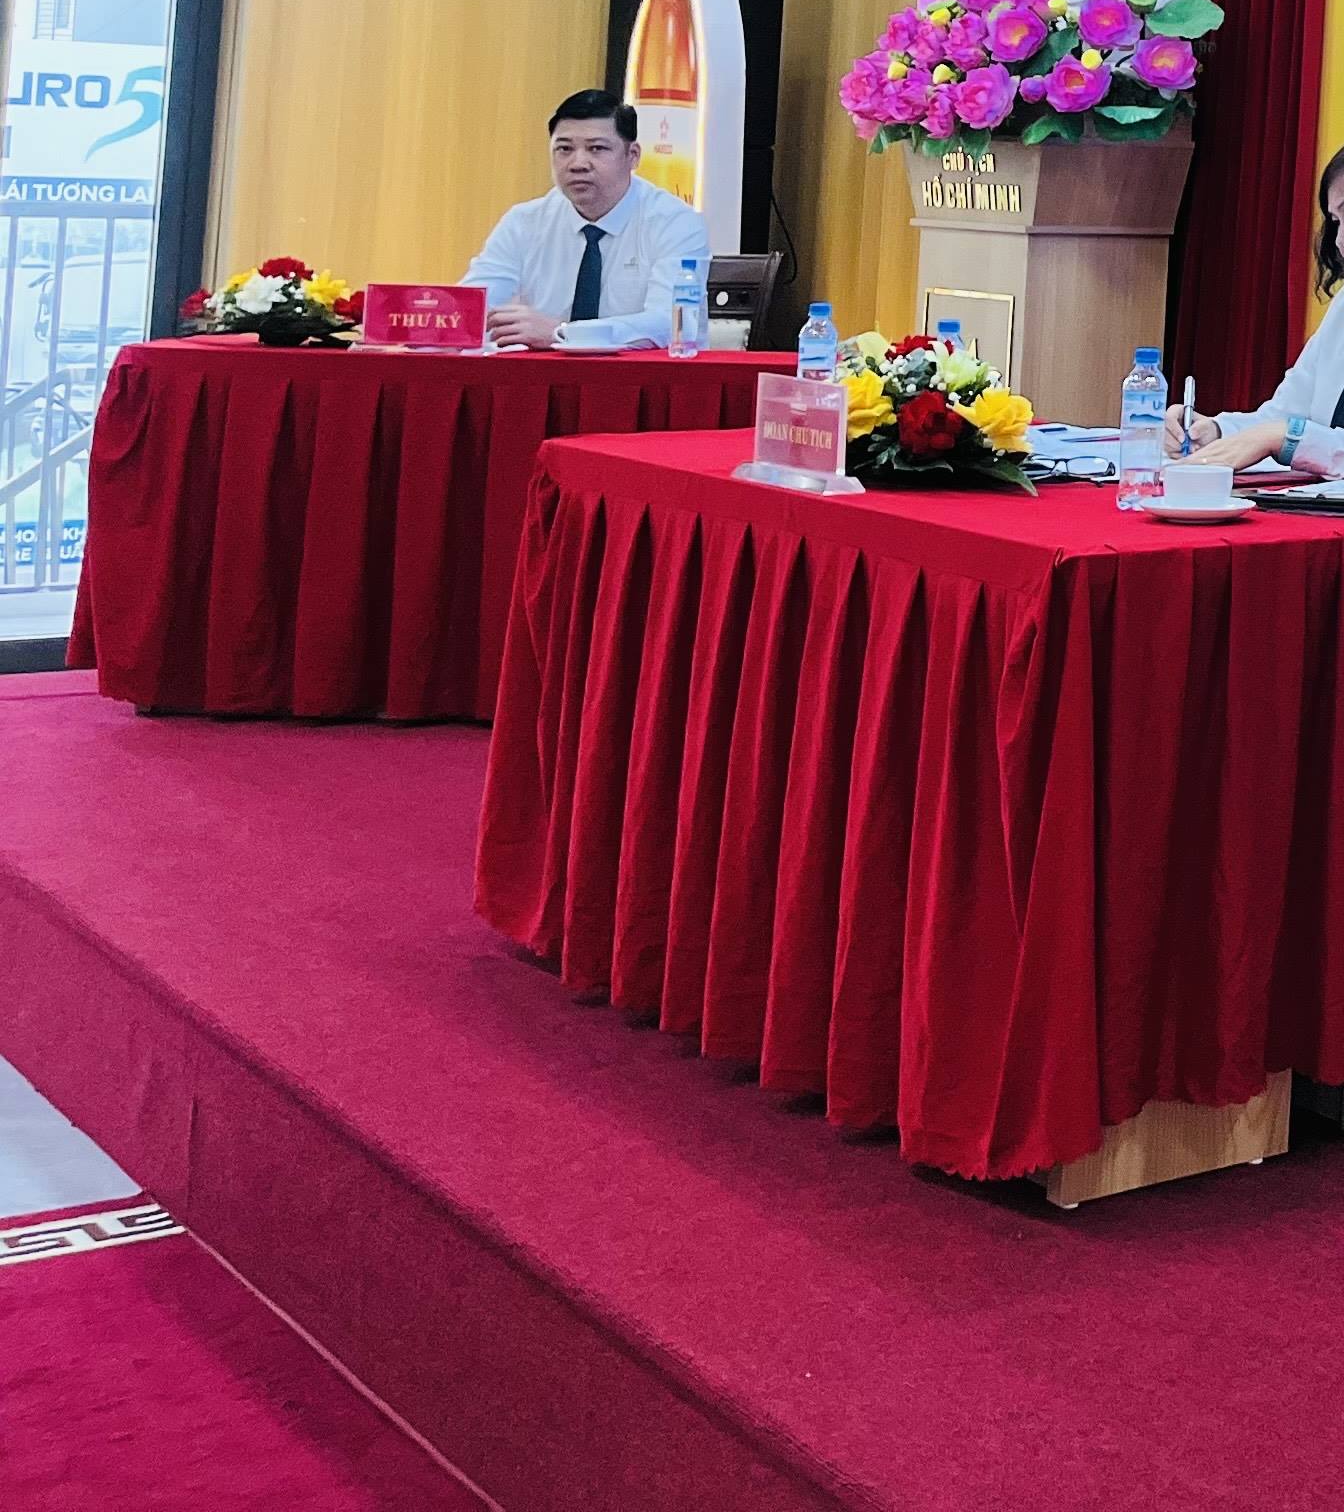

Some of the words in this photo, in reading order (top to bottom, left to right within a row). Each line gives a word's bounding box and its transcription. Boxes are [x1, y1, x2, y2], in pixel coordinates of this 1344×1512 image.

[0, 179, 28, 200] ÁI
[32, 181, 114, 202] TƯƠNG
[945, 176, 973, 209] CHÍ
[975, 183, 1021, 213] MINH
[389, 311, 431, 328] THƯ
